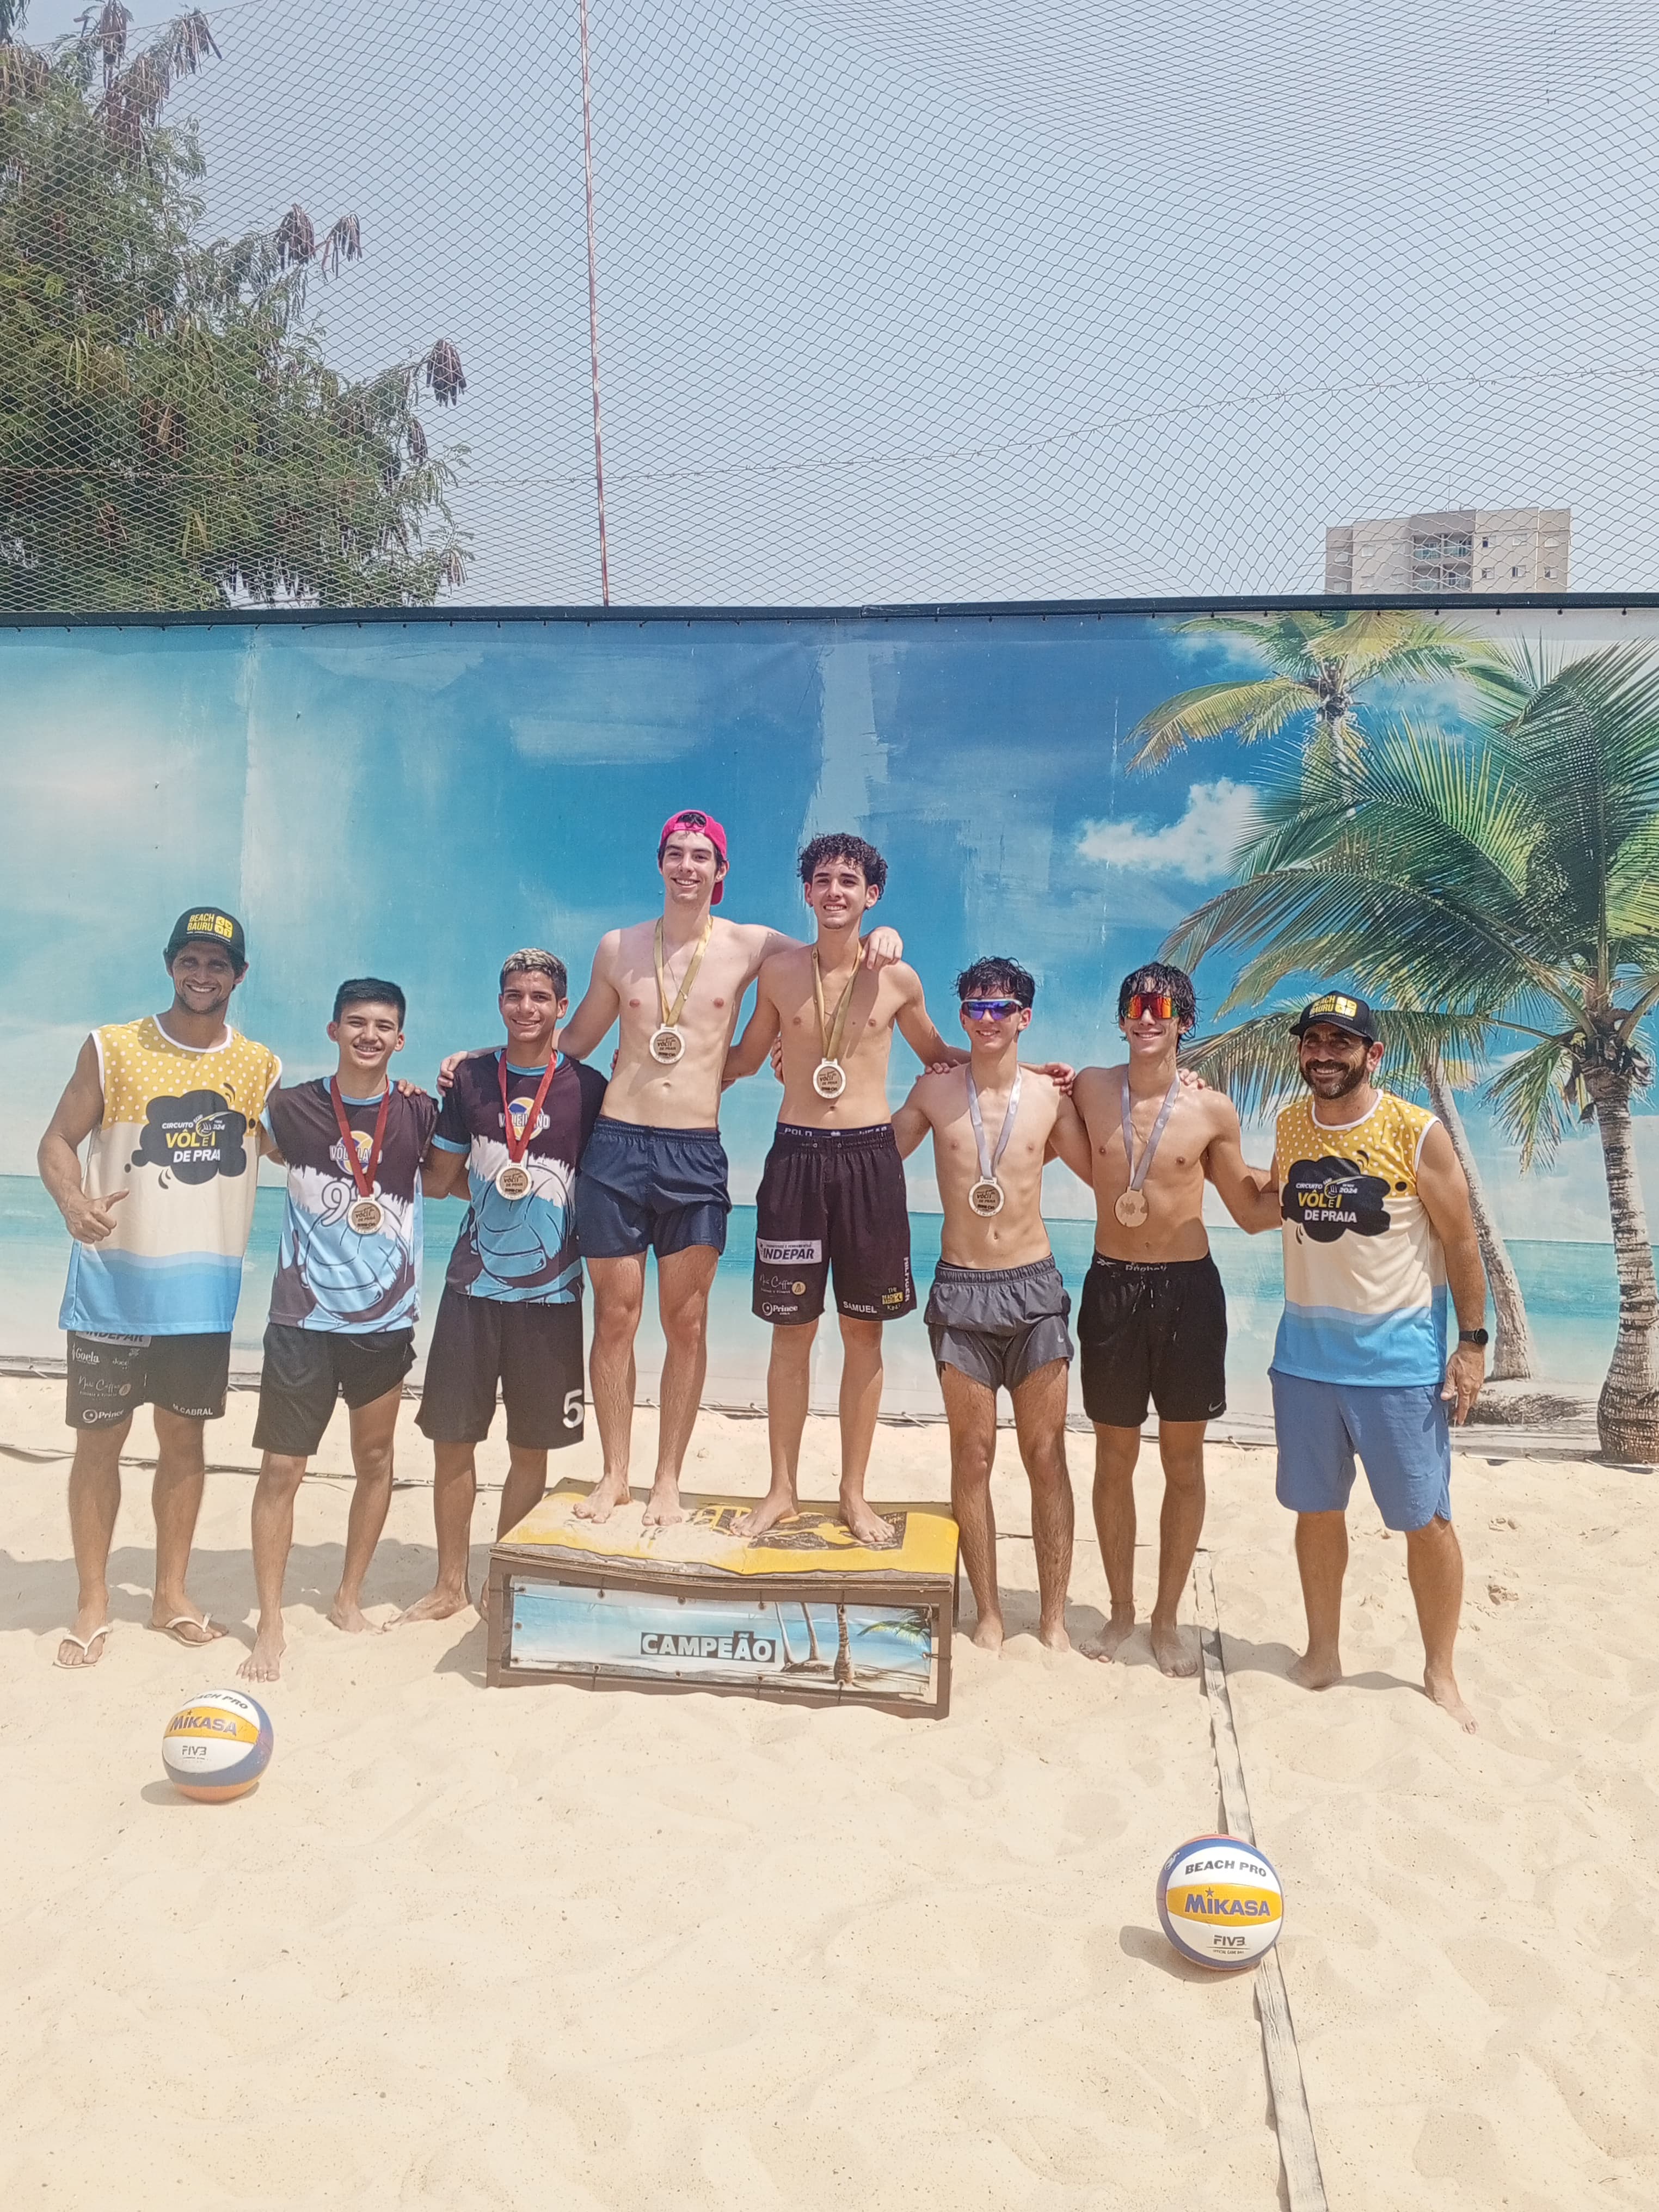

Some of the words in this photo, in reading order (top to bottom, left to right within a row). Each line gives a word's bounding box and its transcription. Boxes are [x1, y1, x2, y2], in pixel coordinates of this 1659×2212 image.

[189, 913, 215, 923] BEACH
[187, 922, 213, 931] BAURU
[165, 1128, 216, 1148] VÔLEI
[173, 1150, 191, 1163] DE
[1298, 1189, 1342, 1208] VÔLEI
[1304, 1209, 1319, 1221] DE
[1321, 1210, 1357, 1222] PRAIA
[764, 1248, 814, 1259] INDEPAR
[843, 1301, 877, 1313] SAMUEL
[563, 1388, 584, 1428] 5
[642, 1633, 772, 1661] CAMPEÃO
[222, 1695, 248, 1709] PRO
[1185, 1860, 1235, 1875] BEACH
[1239, 1861, 1267, 1877] PRO
